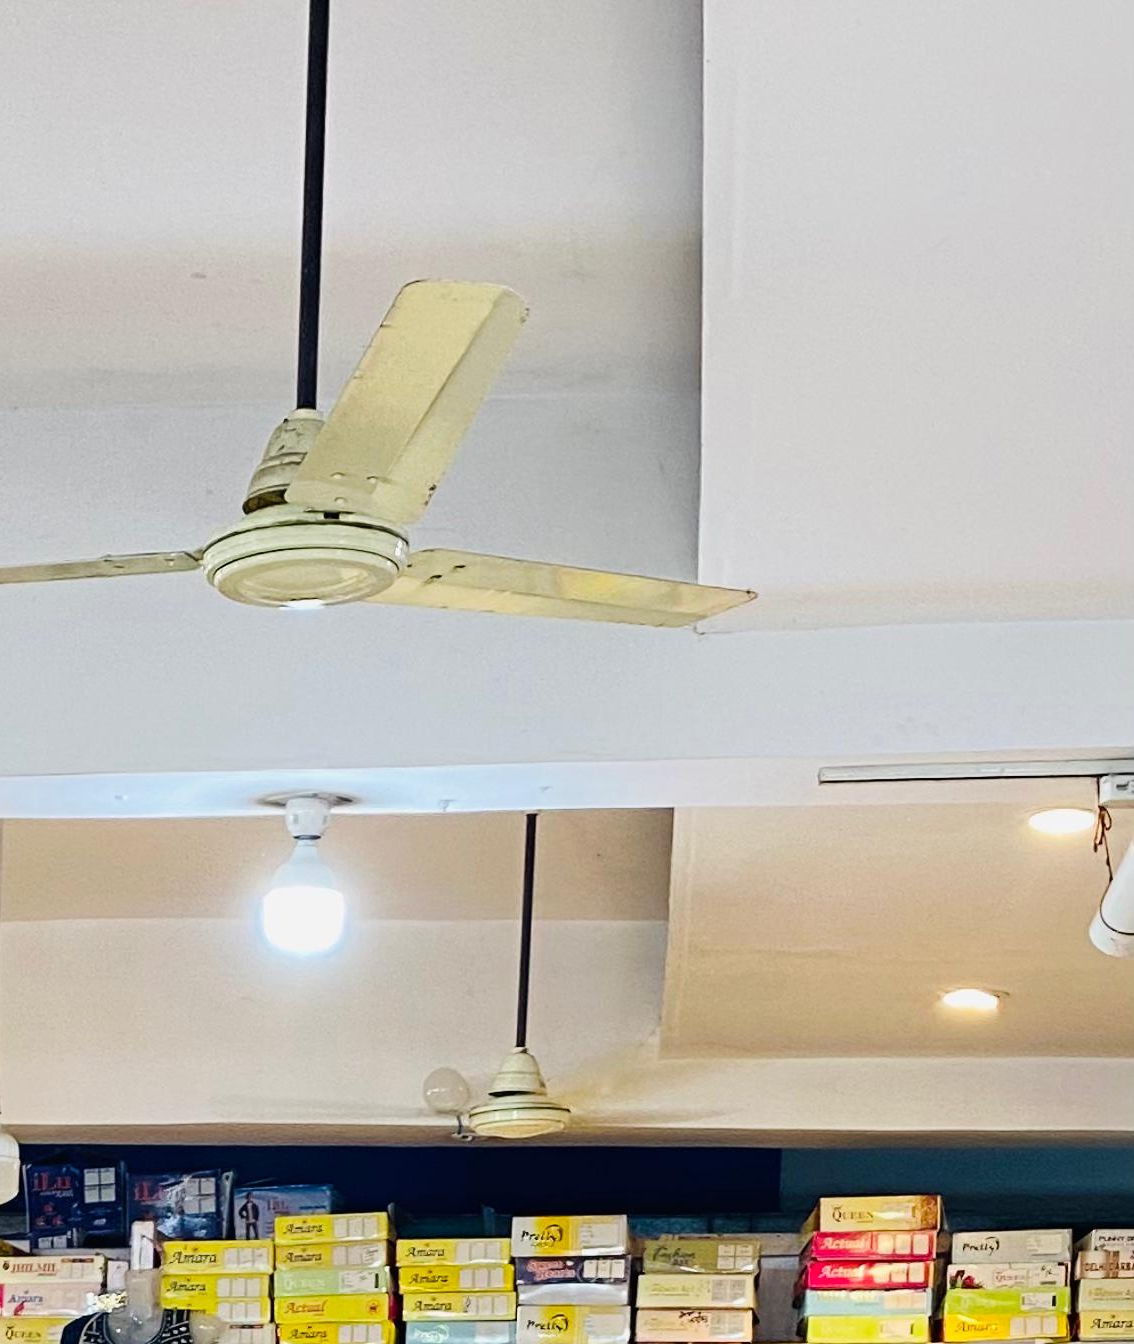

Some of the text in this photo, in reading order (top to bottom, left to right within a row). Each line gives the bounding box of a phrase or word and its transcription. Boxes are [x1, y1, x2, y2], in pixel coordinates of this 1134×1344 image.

[832, 1208, 874, 1223] QUEEN
[283, 1222, 323, 1235] Amara
[169, 1250, 217, 1265] Amara
[166, 1280, 207, 1293] Amara
